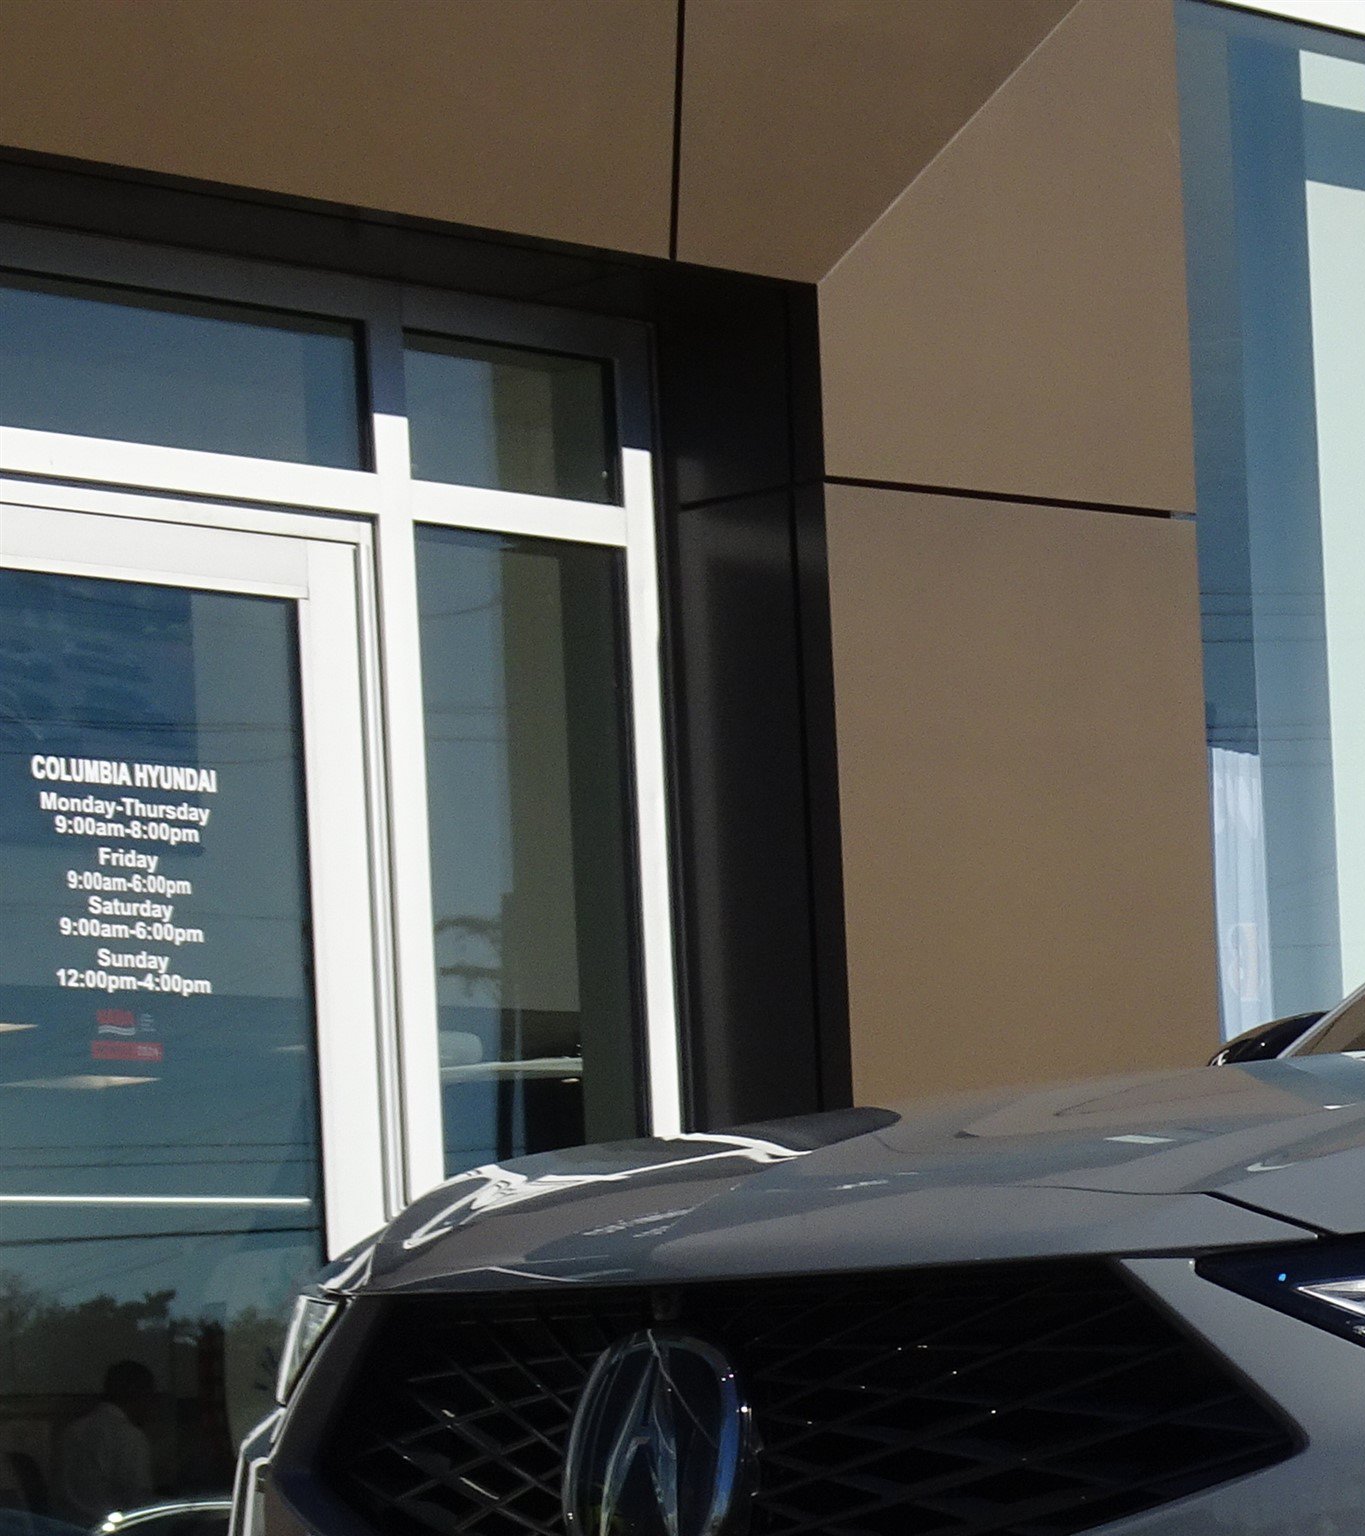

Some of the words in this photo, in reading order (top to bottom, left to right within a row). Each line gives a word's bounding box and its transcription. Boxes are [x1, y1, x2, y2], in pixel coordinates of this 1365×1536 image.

[31, 755, 133, 787] COLUMBIA
[134, 763, 218, 793] HYUNDAI
[39, 791, 210, 826] Monday-Thursday
[54, 815, 200, 845] 9:00am-8:00pm
[98, 847, 159, 873] Friday
[67, 870, 192, 898] 9:00am-6:00pm
[88, 896, 173, 922] Saturday
[59, 917, 205, 945] 9:00am-6:00pm
[97, 948, 170, 973] Sunday
[56, 968, 212, 996] 12:00pm-4:00pm
